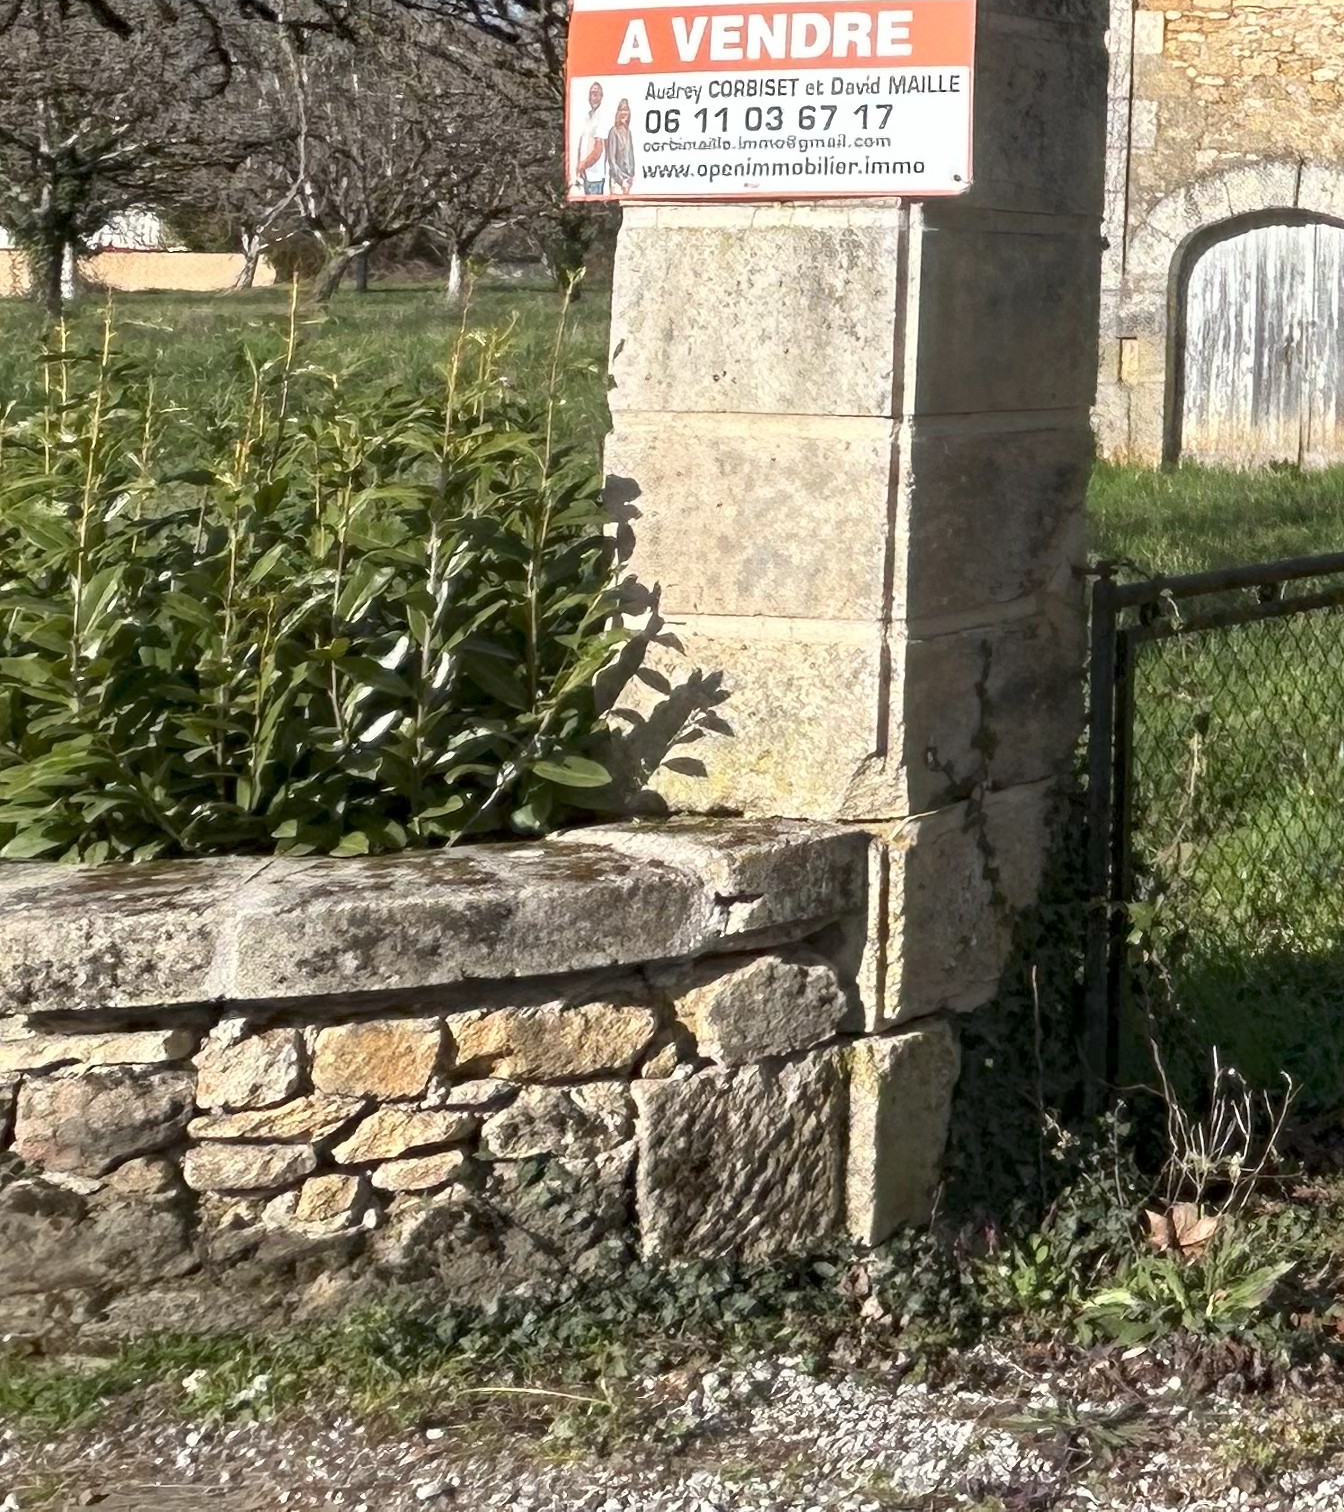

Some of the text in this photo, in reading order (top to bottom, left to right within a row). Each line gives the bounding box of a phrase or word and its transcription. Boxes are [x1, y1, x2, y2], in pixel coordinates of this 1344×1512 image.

[616, 9, 914, 65] A VENDRE
[645, 74, 960, 104] Audrey CORBISET et David MAILLE
[645, 104, 893, 134] 06 11 03 67 17
[642, 156, 925, 183] www.openimmobilier.immo
